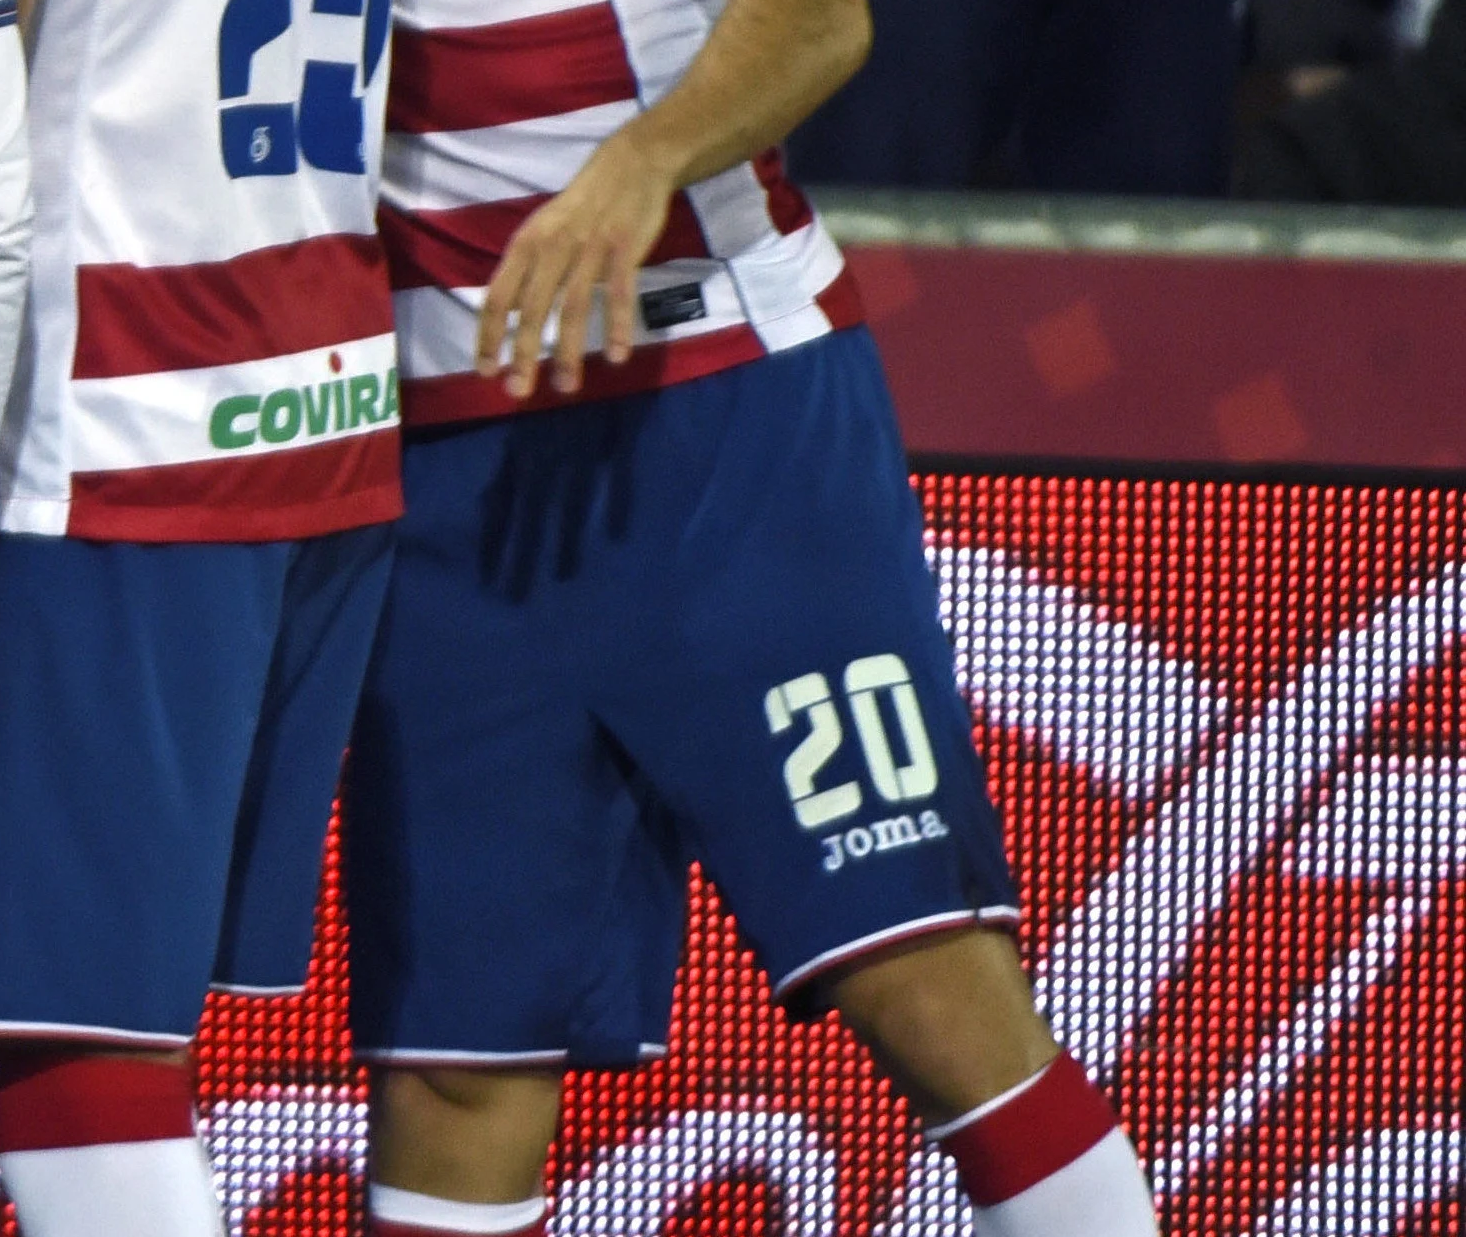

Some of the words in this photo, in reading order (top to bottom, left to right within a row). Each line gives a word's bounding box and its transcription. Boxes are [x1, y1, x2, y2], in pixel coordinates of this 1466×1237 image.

[208, 351, 400, 450] COVIRA
[763, 652, 939, 830] 20
[820, 809, 950, 873] Joma
